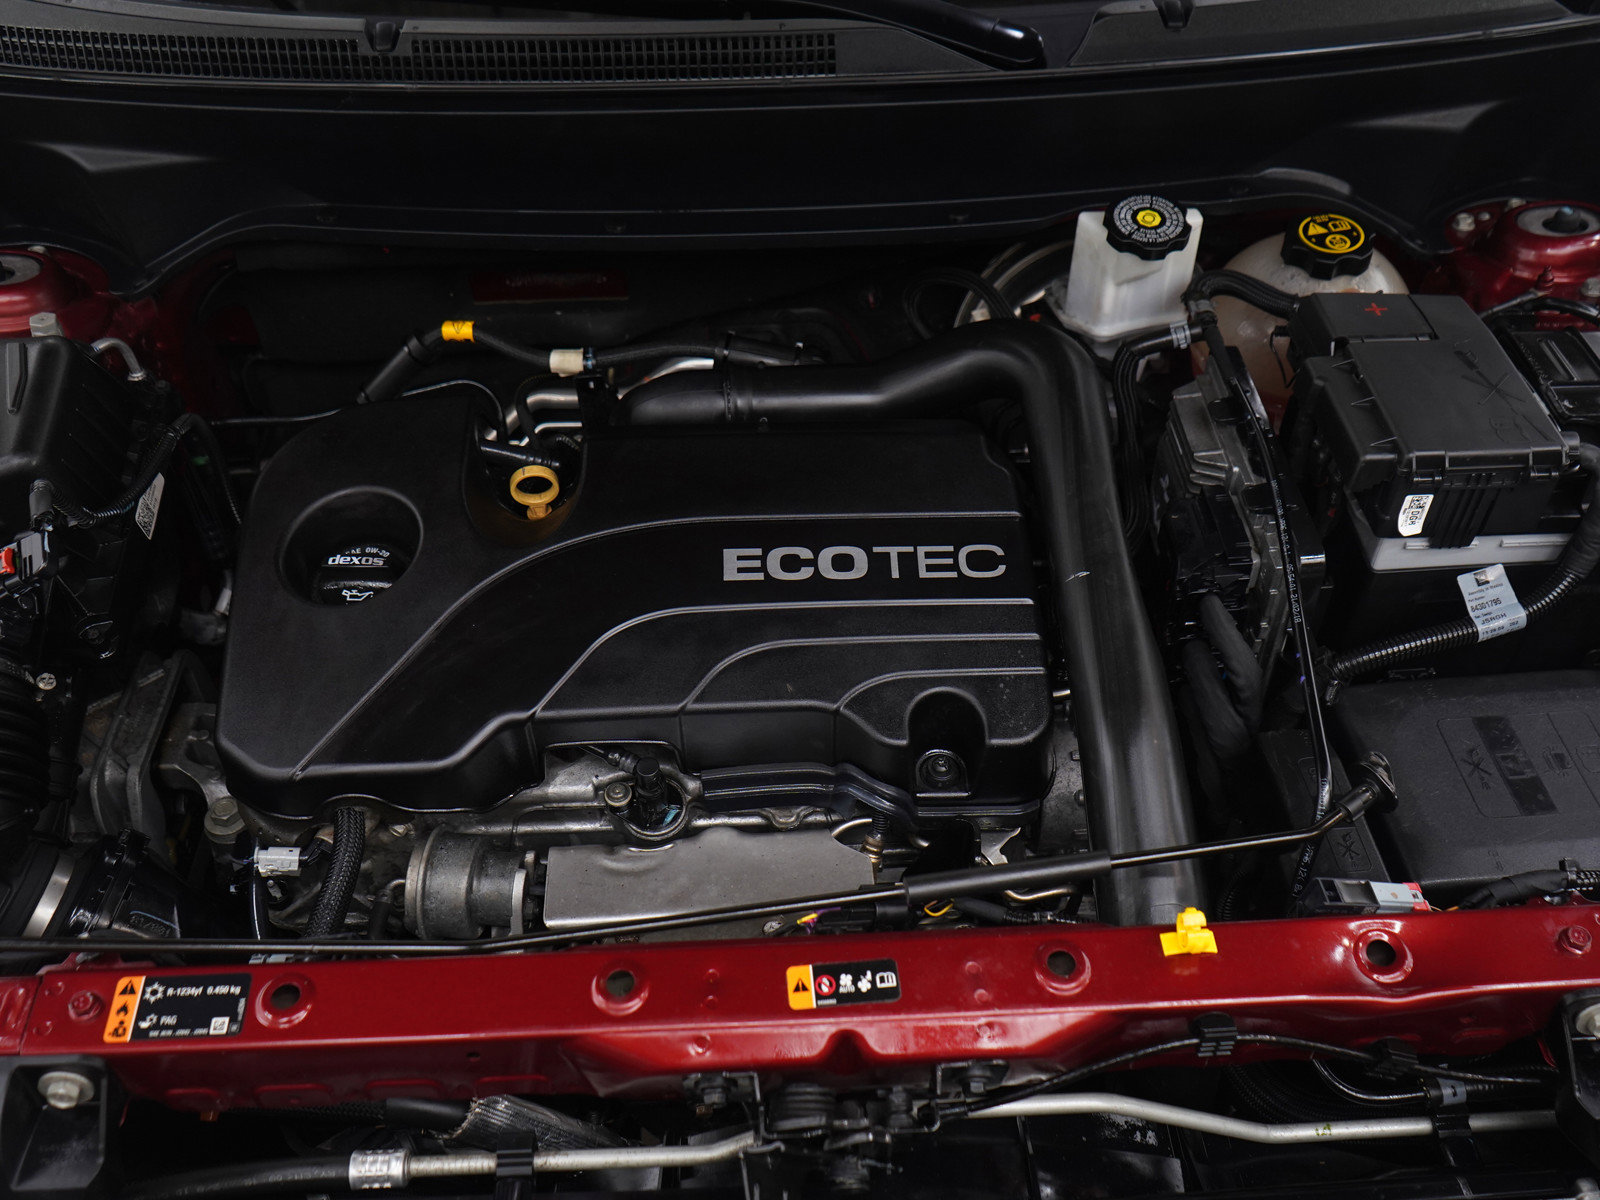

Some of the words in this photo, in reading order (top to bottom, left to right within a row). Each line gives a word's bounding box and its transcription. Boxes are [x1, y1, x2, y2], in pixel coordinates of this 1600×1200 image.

[365, 546, 391, 558] 0W-20
[327, 554, 385, 566] dexos
[723, 544, 1007, 581] ECOTEC
[167, 985, 204, 997] R-1234yf
[207, 985, 229, 996] 0.450
[230, 984, 242, 996] kg
[839, 985, 855, 993] AUTO
[160, 1015, 178, 1026] PAG
